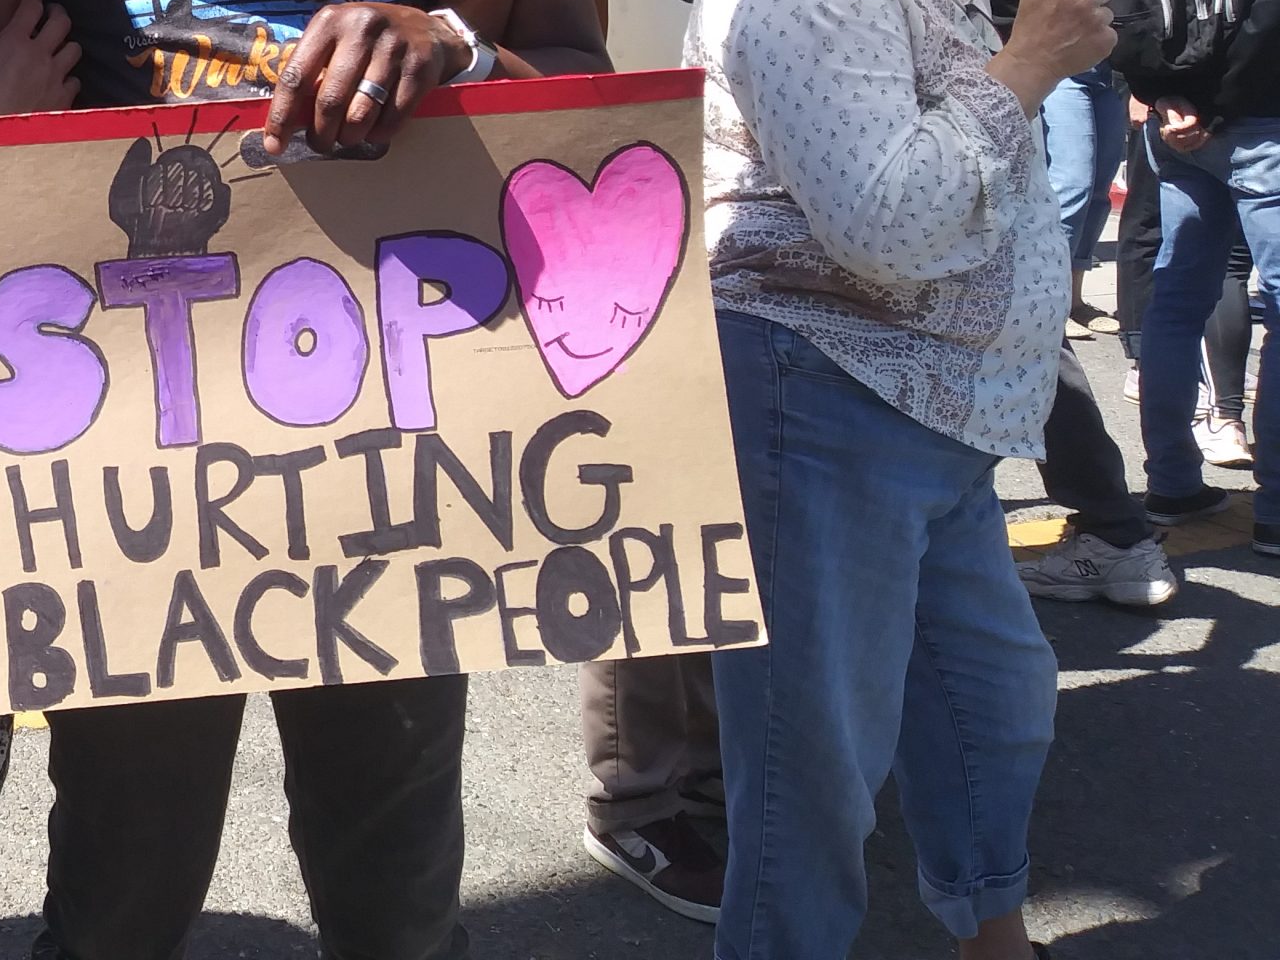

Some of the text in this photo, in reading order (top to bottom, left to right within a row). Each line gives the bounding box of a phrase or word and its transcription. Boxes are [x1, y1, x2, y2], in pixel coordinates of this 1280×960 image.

[5, 409, 634, 572] HURTING
[2, 522, 760, 711] BLACK PEOPLE
